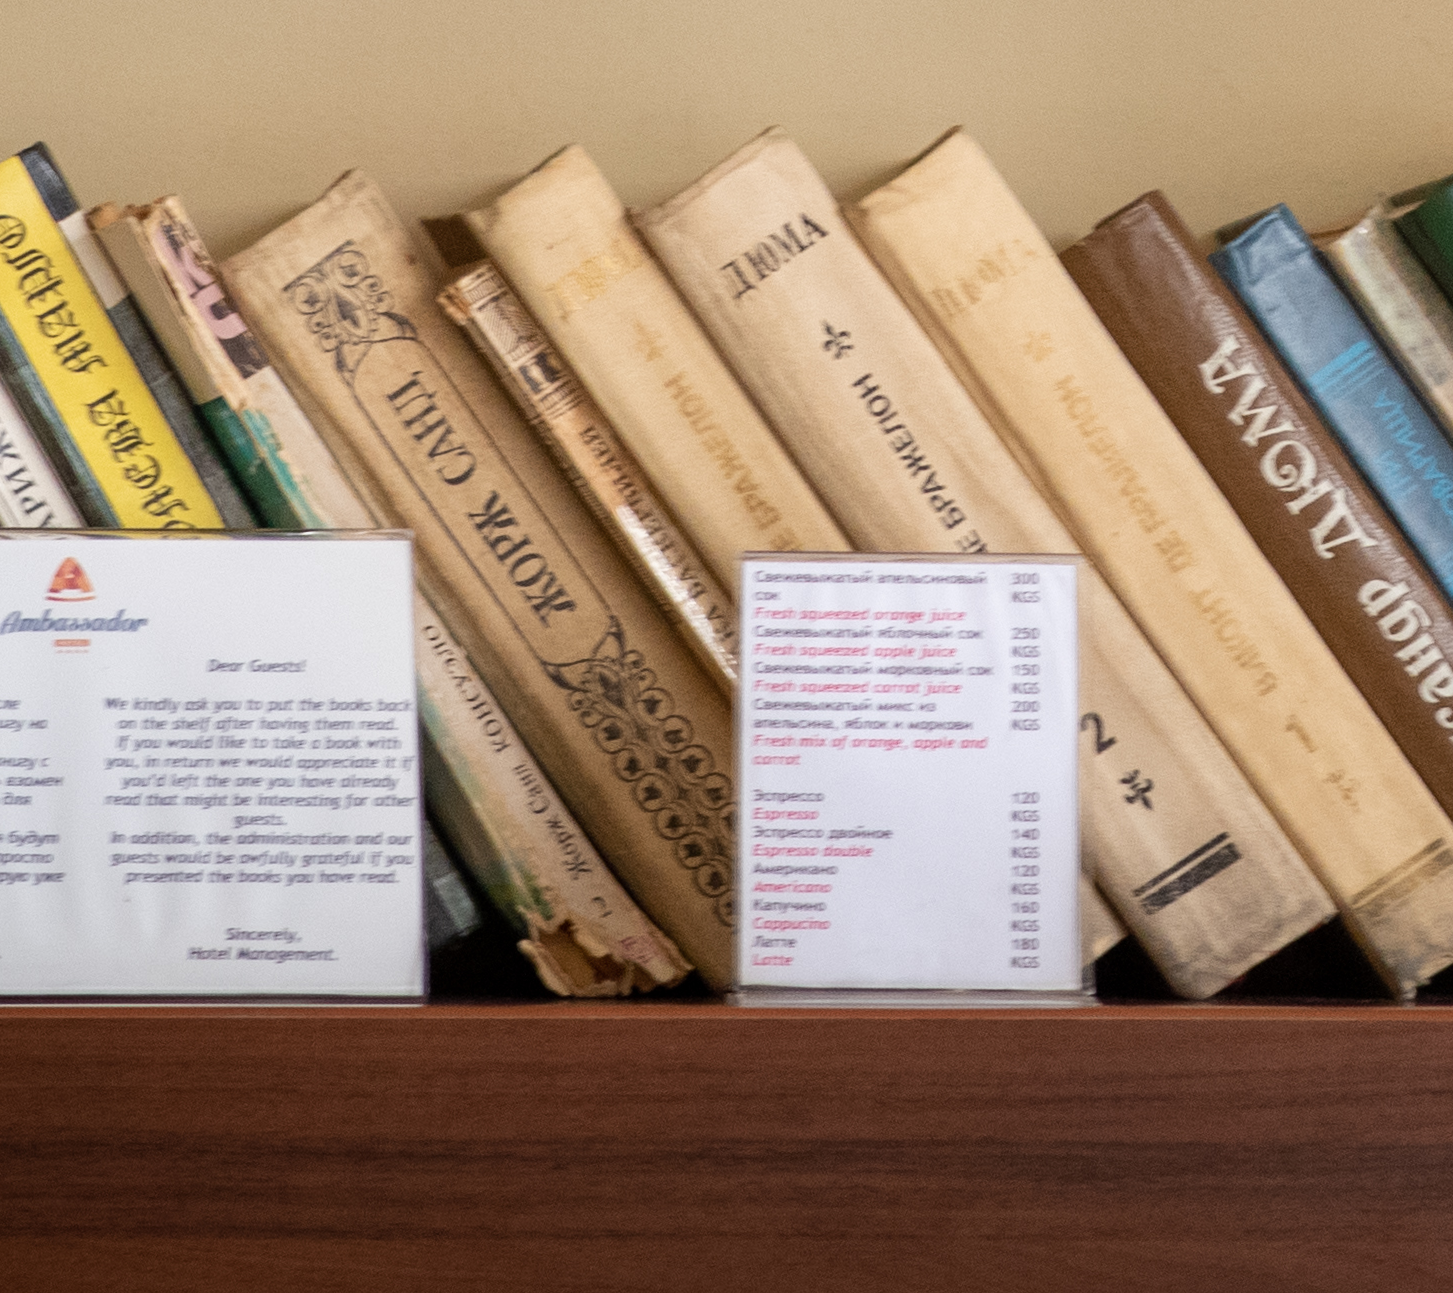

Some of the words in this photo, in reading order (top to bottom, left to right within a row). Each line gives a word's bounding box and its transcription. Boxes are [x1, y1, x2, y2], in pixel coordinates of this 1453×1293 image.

[719, 205, 831, 300] ДЮМА
[382, 368, 483, 490] САНД
[847, 371, 970, 532] БРАЖЕЛОН
[1188, 326, 1379, 575] ДЮМА
[463, 490, 577, 627] ЖОРЖ
[1011, 572, 1040, 585] 300
[753, 608, 796, 621] Fresh
[875, 610, 924, 623] orange
[928, 608, 966, 623] juice
[208, 659, 245, 672] Dear
[251, 659, 306, 672] Guests!
[134, 697, 180, 713] kindly
[213, 700, 242, 713] you
[331, 697, 372, 710] books
[753, 809, 819, 821] Espresso
[226, 927, 301, 943] Sincerely,
[189, 947, 230, 961] Hotel
[237, 947, 338, 963] Management.
